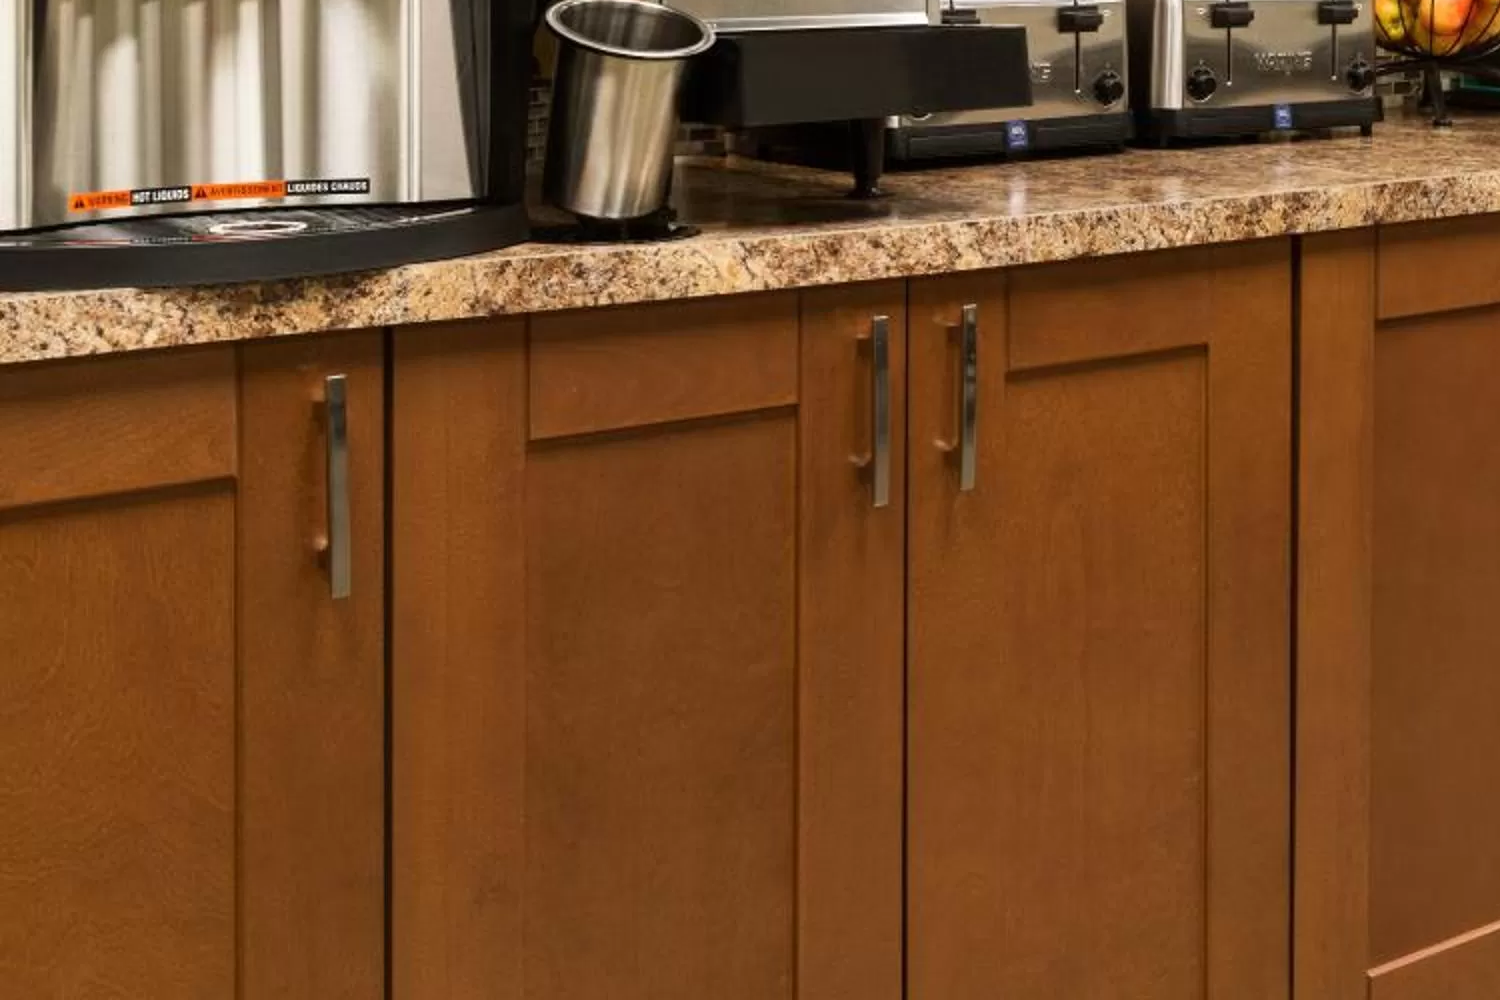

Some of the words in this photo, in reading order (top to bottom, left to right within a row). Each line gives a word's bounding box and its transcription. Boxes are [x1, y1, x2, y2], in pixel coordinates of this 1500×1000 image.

[132, 191, 150, 203] HOT
[152, 188, 190, 202] LIQUIDS
[287, 182, 329, 194] LIQUIDES
[330, 180, 368, 192] CHAUDS
